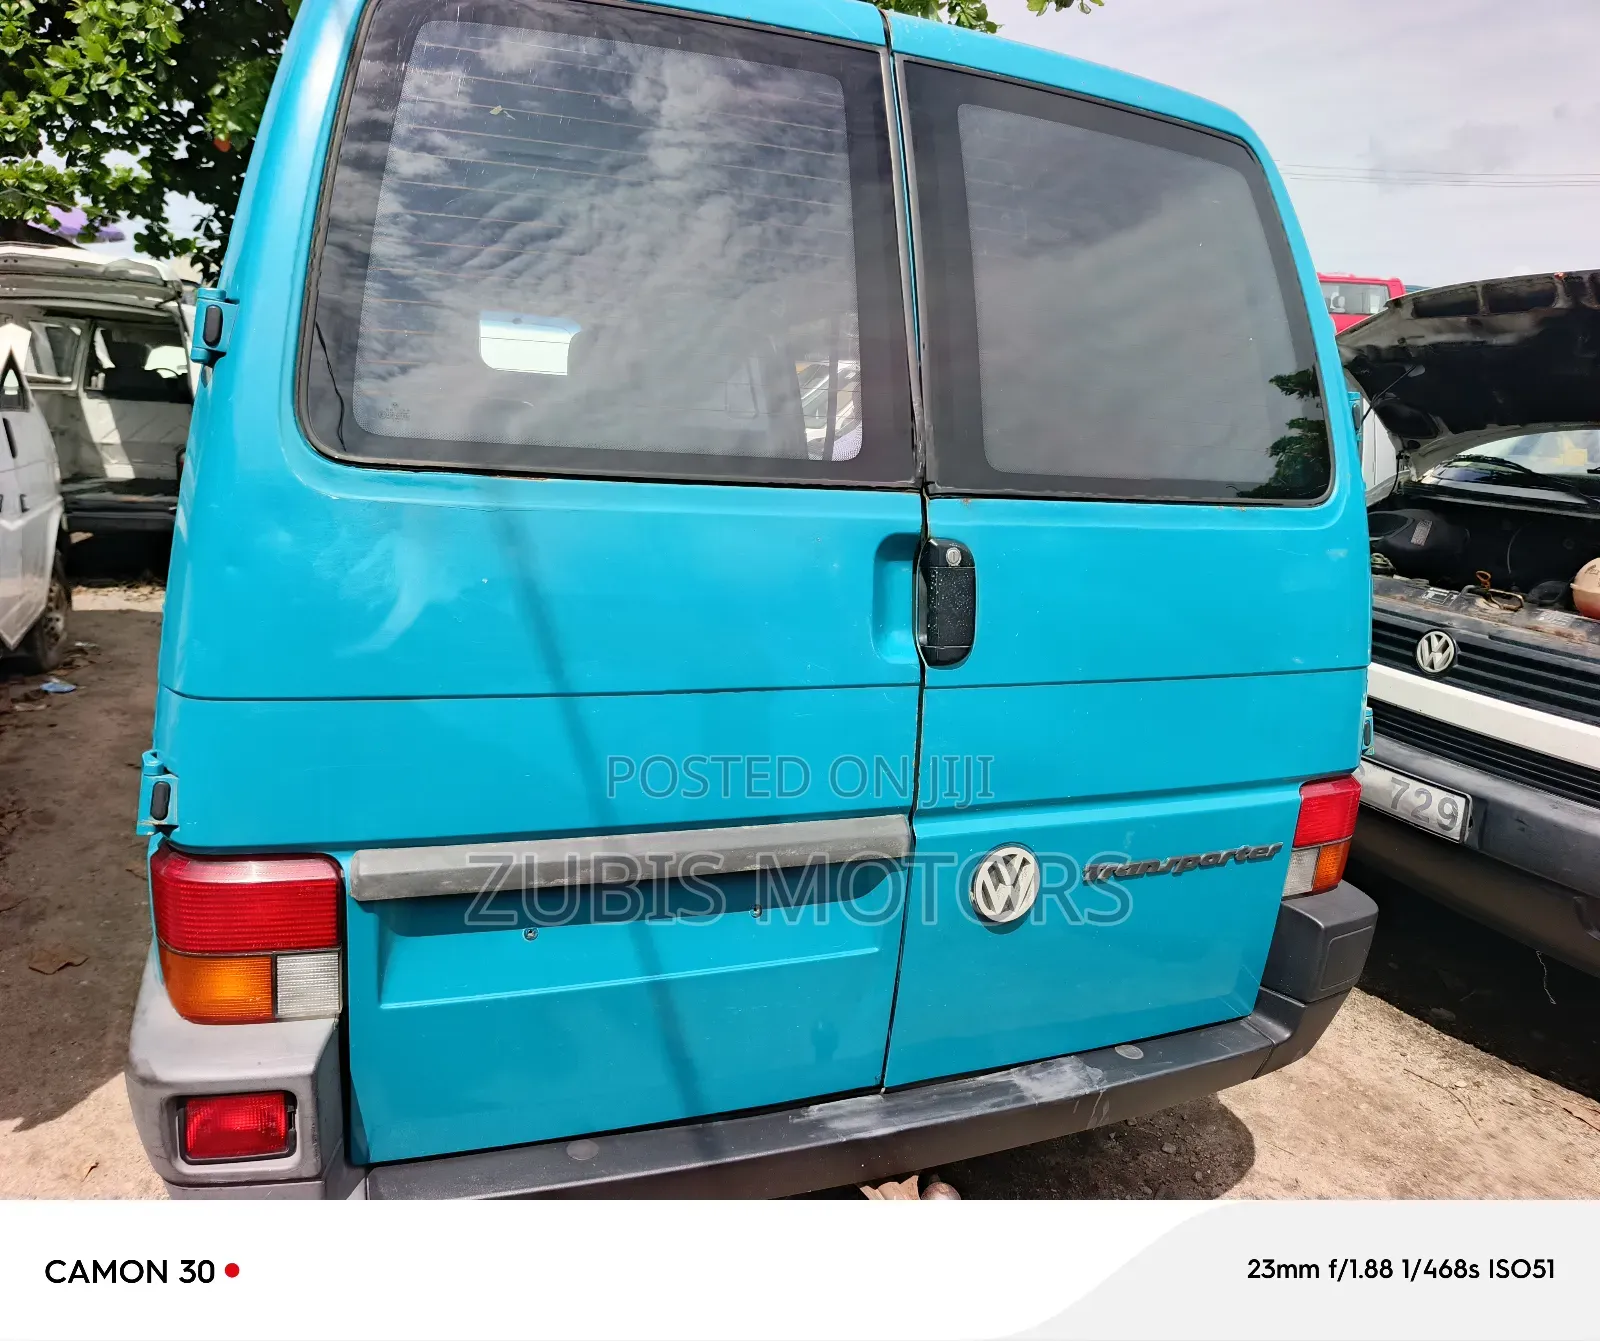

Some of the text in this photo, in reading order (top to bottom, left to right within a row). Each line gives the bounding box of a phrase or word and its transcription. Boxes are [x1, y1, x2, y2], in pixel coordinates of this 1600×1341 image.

[1416, 631, 1455, 673] VW
[1391, 777, 1459, 832] 729
[972, 844, 1040, 923] VW
